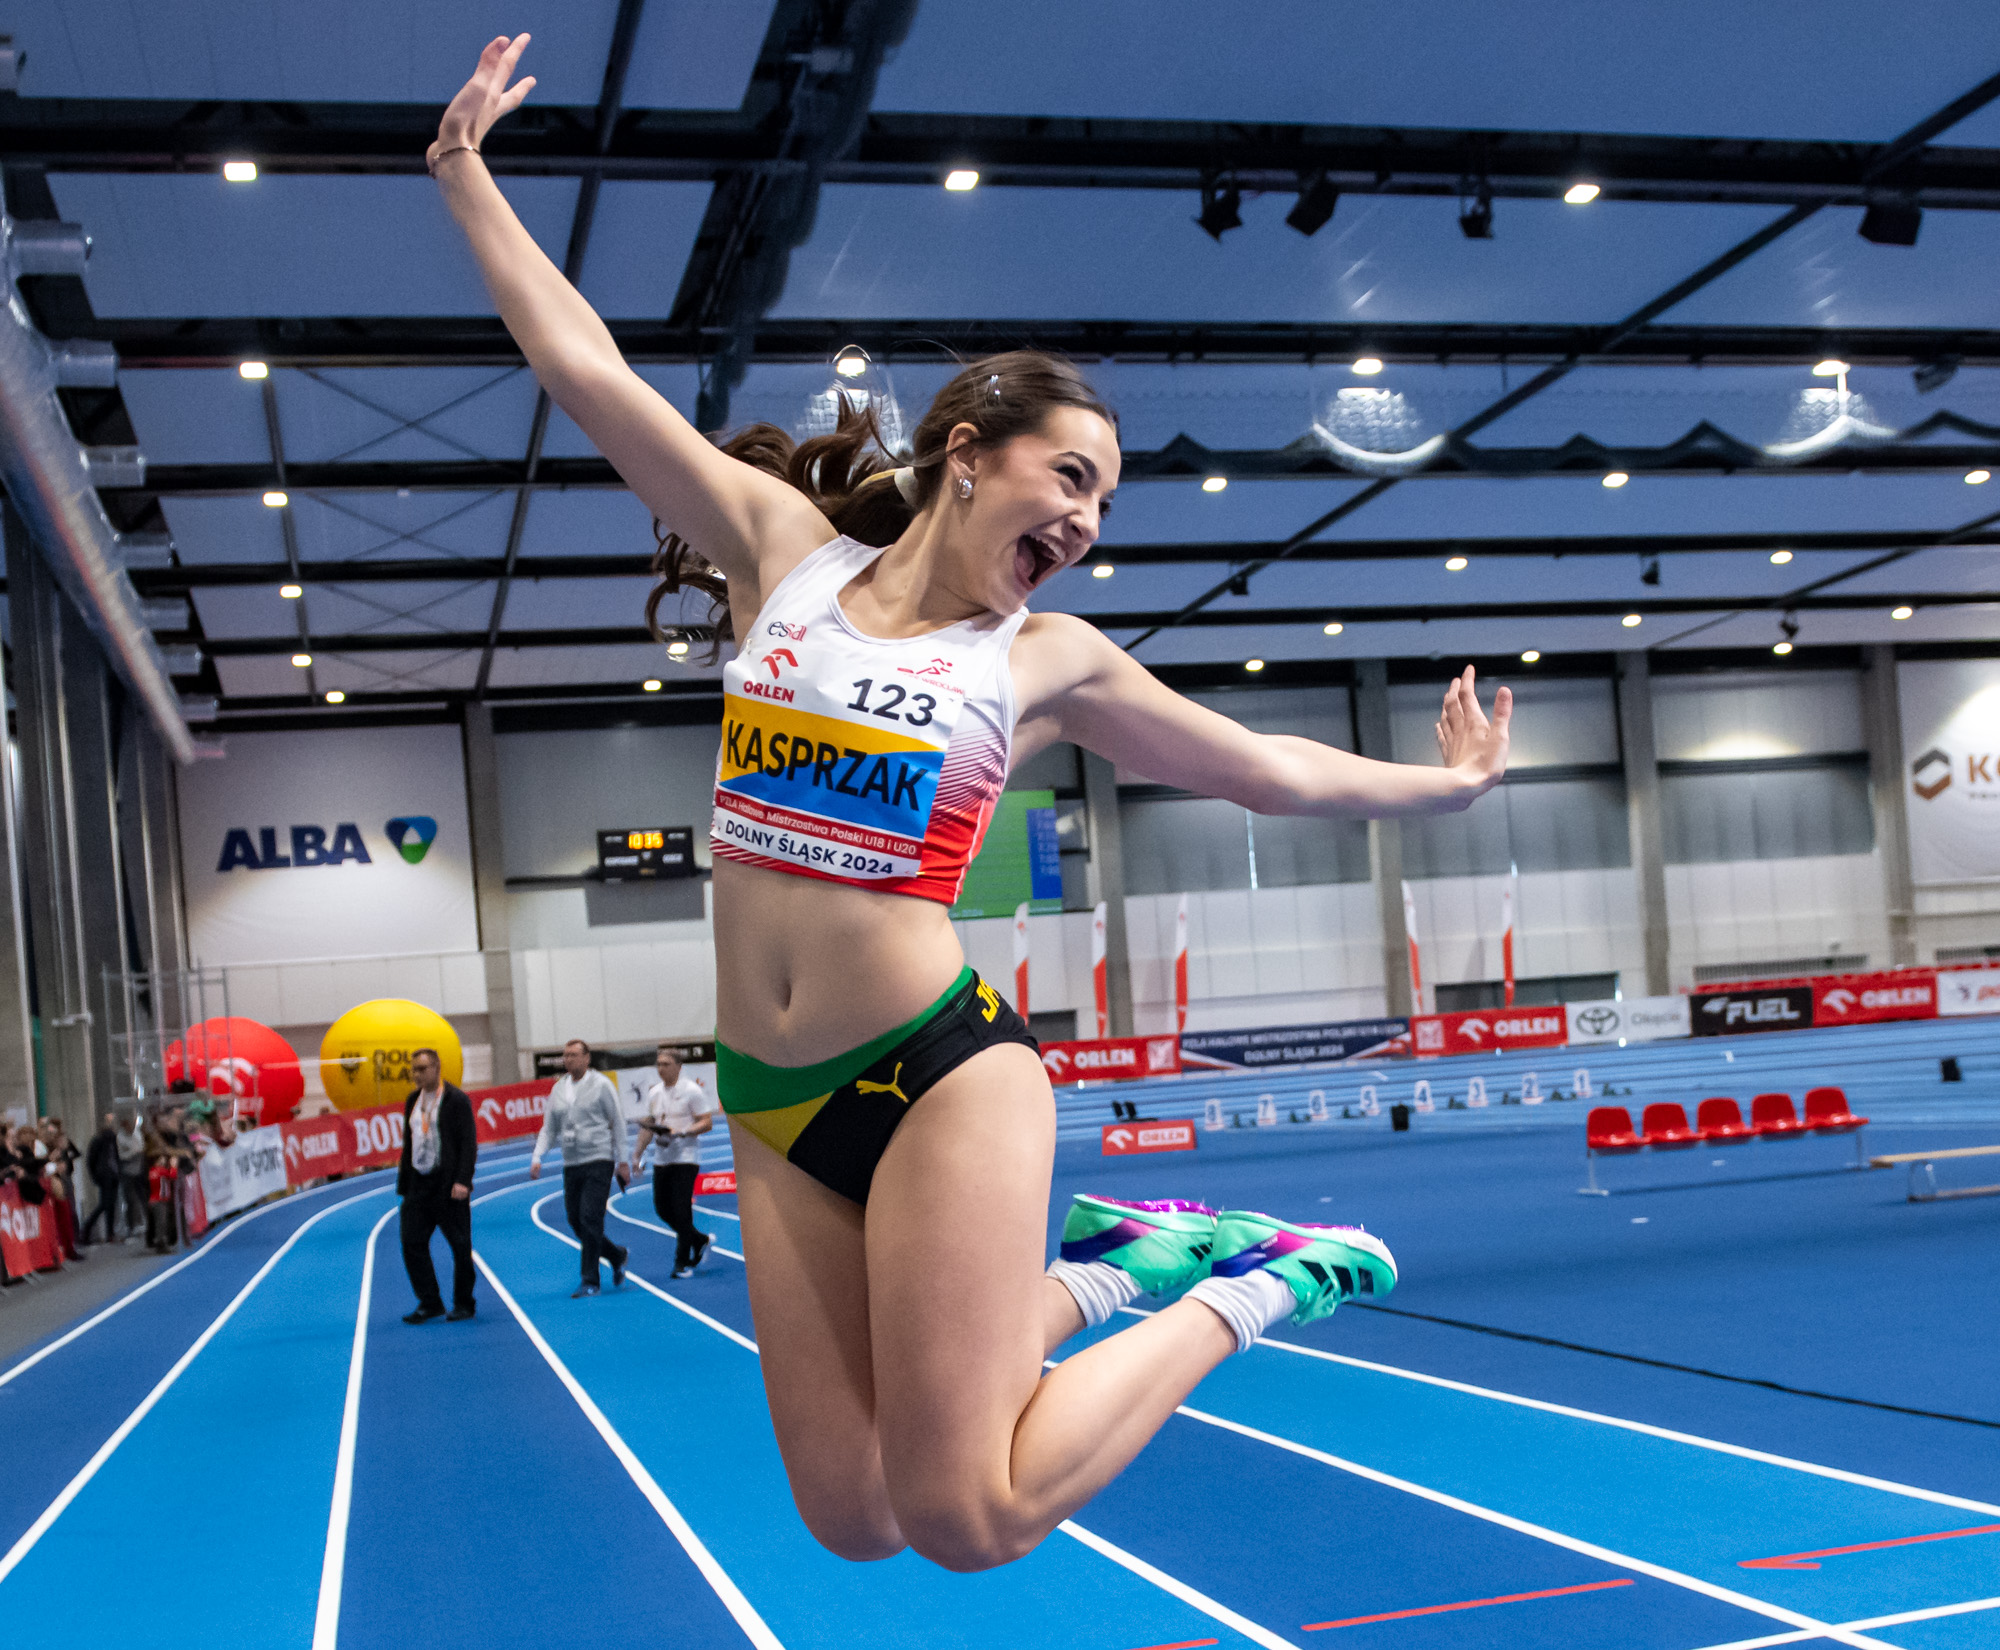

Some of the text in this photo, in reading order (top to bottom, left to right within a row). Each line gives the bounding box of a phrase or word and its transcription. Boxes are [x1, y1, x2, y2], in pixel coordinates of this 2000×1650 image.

[743, 680, 794, 703] ORLEN
[847, 678, 937, 726] 123
[727, 719, 927, 811] KASPRZAK
[1968, 755, 2000, 783] K
[738, 802, 764, 819] Halowe
[766, 811, 828, 835] Mistrzostwa
[830, 826, 863, 843] Polski
[865, 835, 885, 849] U18
[893, 841, 916, 855] U20
[216, 823, 372, 872] ALBA
[725, 819, 893, 874] DOLNY ŚLĄSK 2024
[1860, 986, 1931, 1008] ORLEN
[1493, 1017, 1560, 1037] ORLEN
[1074, 1048, 1136, 1069] ORLEN
[702, 1177, 737, 1190] PZL
